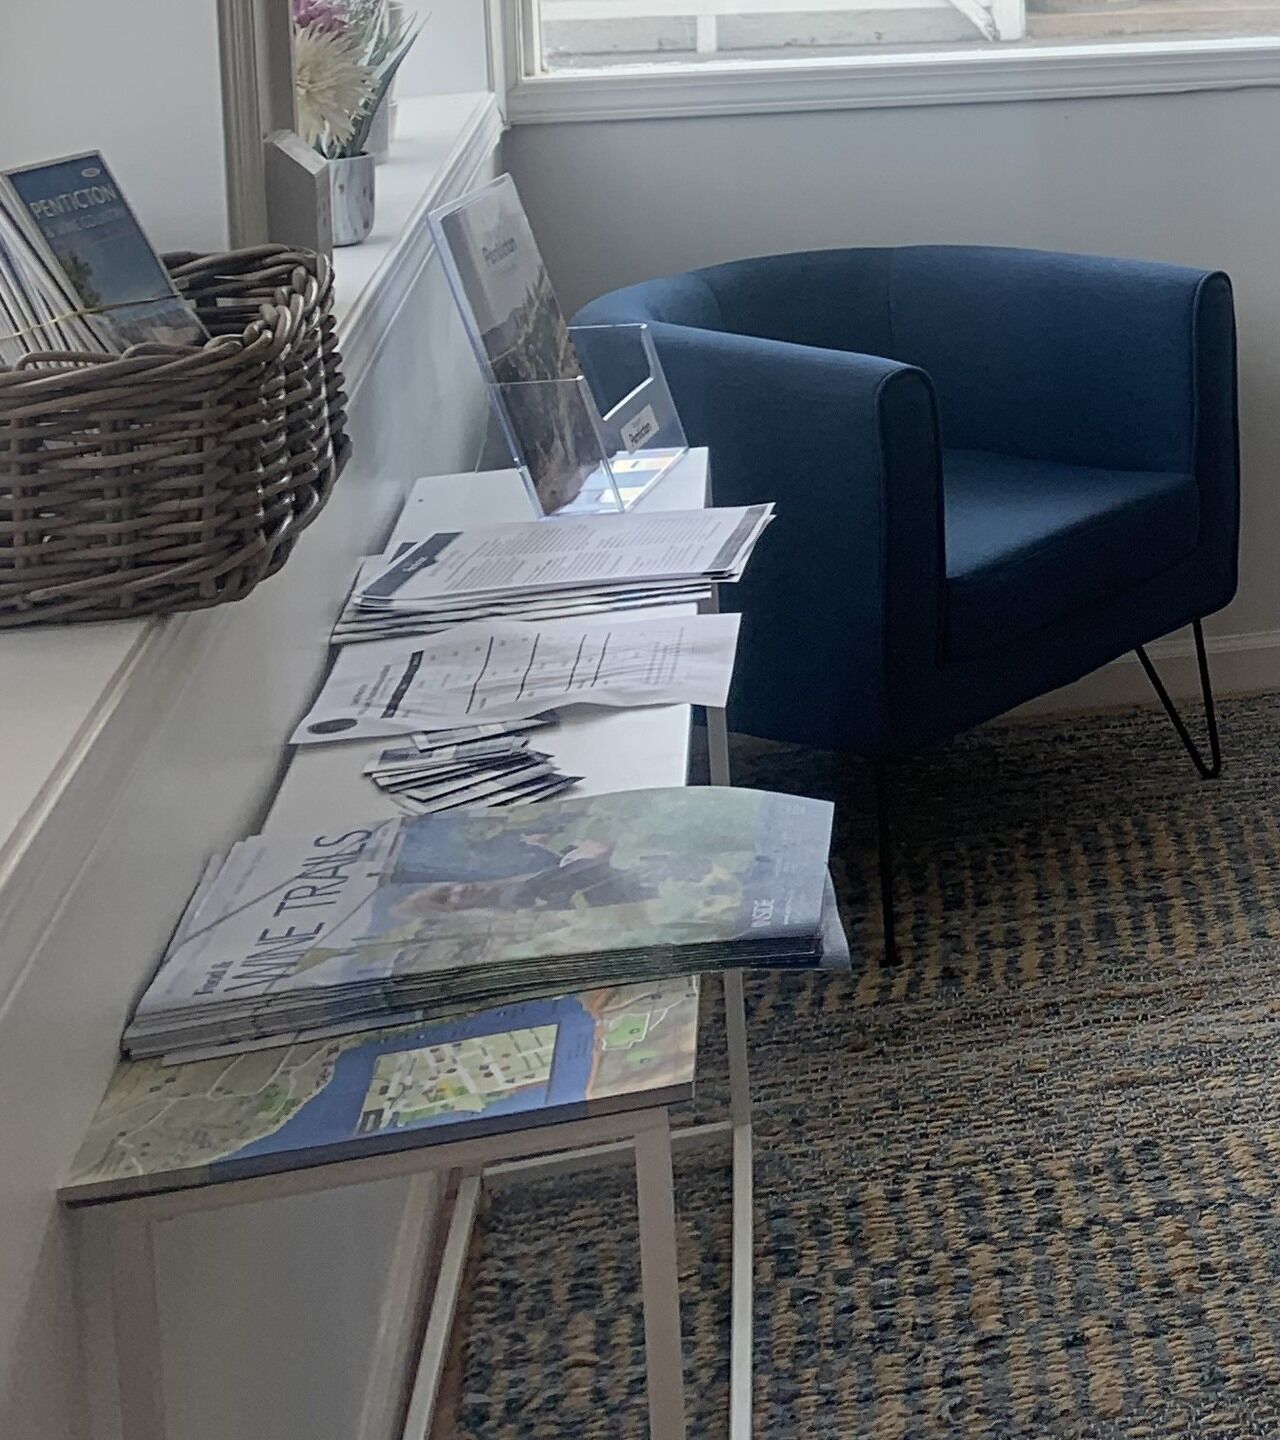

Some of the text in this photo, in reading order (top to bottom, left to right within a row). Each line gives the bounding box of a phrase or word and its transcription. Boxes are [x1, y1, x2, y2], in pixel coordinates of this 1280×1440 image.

[29, 185, 119, 219] PENTICTON
[273, 829, 373, 918] TRAILS
[223, 921, 325, 992] WINE
